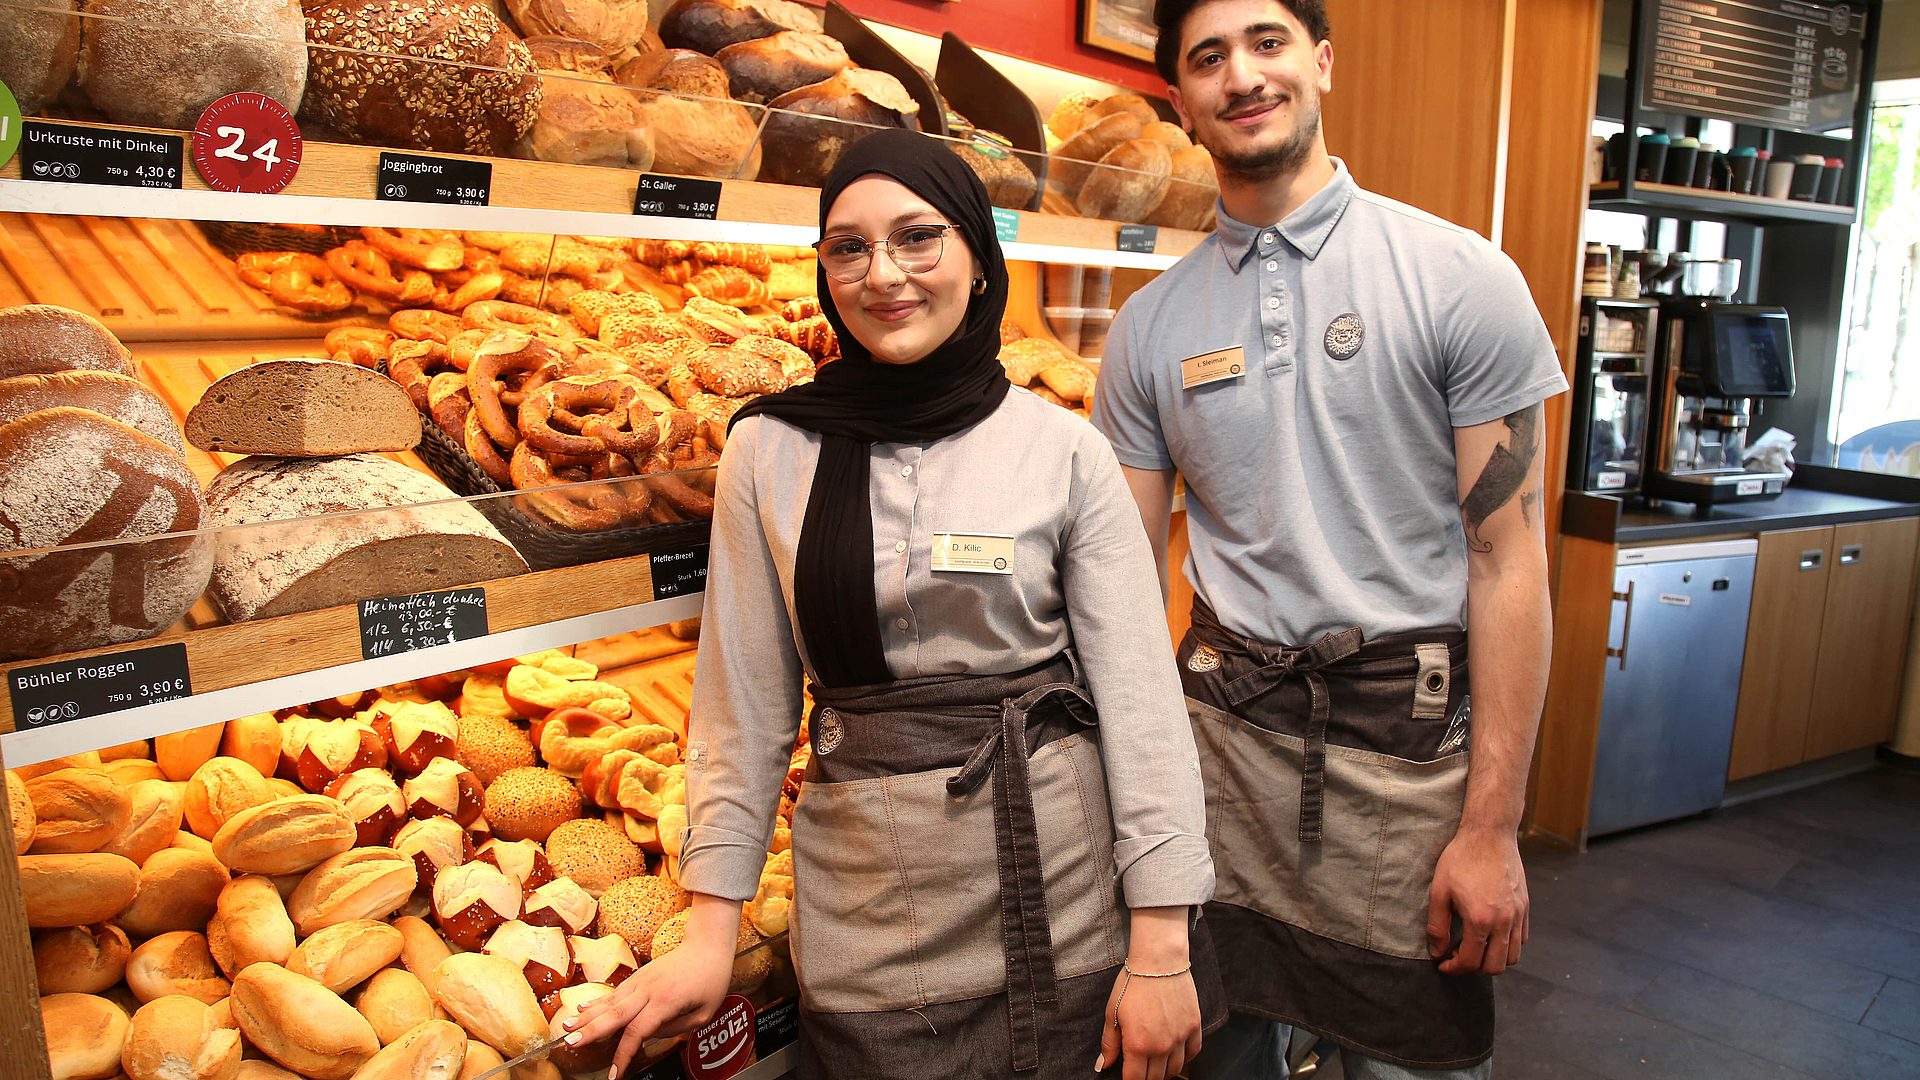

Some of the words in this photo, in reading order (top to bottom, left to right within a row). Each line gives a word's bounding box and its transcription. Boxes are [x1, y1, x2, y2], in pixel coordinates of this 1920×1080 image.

[1660, 10, 1693, 24] ESPRESSO
[1659, 23, 1701, 39] CAPPUCCINO
[1658, 37, 1702, 53] MILCHKAFFEE
[1657, 50, 1676, 61] LATTE
[1677, 54, 1715, 69] MACCHIATO
[1672, 67, 1695, 78] WHITE
[1674, 80, 1718, 95] SCHOKOLADE
[29, 130, 94, 147] Urkruste
[98, 137, 122, 150] mit
[126, 139, 168, 154] Dinkel
[215, 126, 281, 173] 24
[106, 166, 122, 175] 750
[123, 168, 129, 177] g
[135, 165, 164, 179] 4,30
[167, 167, 176, 179] €
[382, 159, 443, 174] Joggingbrot
[141, 179, 155, 187] 5,73
[641, 179, 651, 189] St.
[653, 180, 677, 191] Galler
[435, 188, 447, 196] 750
[456, 187, 477, 198] 3,90
[478, 189, 485, 199] €
[692, 202, 709, 212] 3,90
[709, 203, 716, 212] €
[1202, 356, 1227, 367] Sleiman
[952, 543, 961, 552] D.
[964, 543, 982, 552] Kilic
[445, 605, 457, 616] €
[365, 622, 390, 637] 1/2
[442, 616, 454, 629] €
[369, 638, 395, 656] 1/4
[17, 670, 72, 690] Bühler
[77, 660, 135, 680] Roggen
[108, 693, 124, 703] 750
[126, 693, 132, 701] g
[139, 680, 171, 697] 3,90
[174, 678, 184, 690] €
[696, 1019, 719, 1039] Unser
[719, 1001, 744, 1026] ganzer
[757, 1003, 795, 1026] Bäckerburger
[758, 1023, 768, 1033] mit
[768, 1014, 787, 1028] Sesam
[697, 1010, 749, 1059] Stolz!
